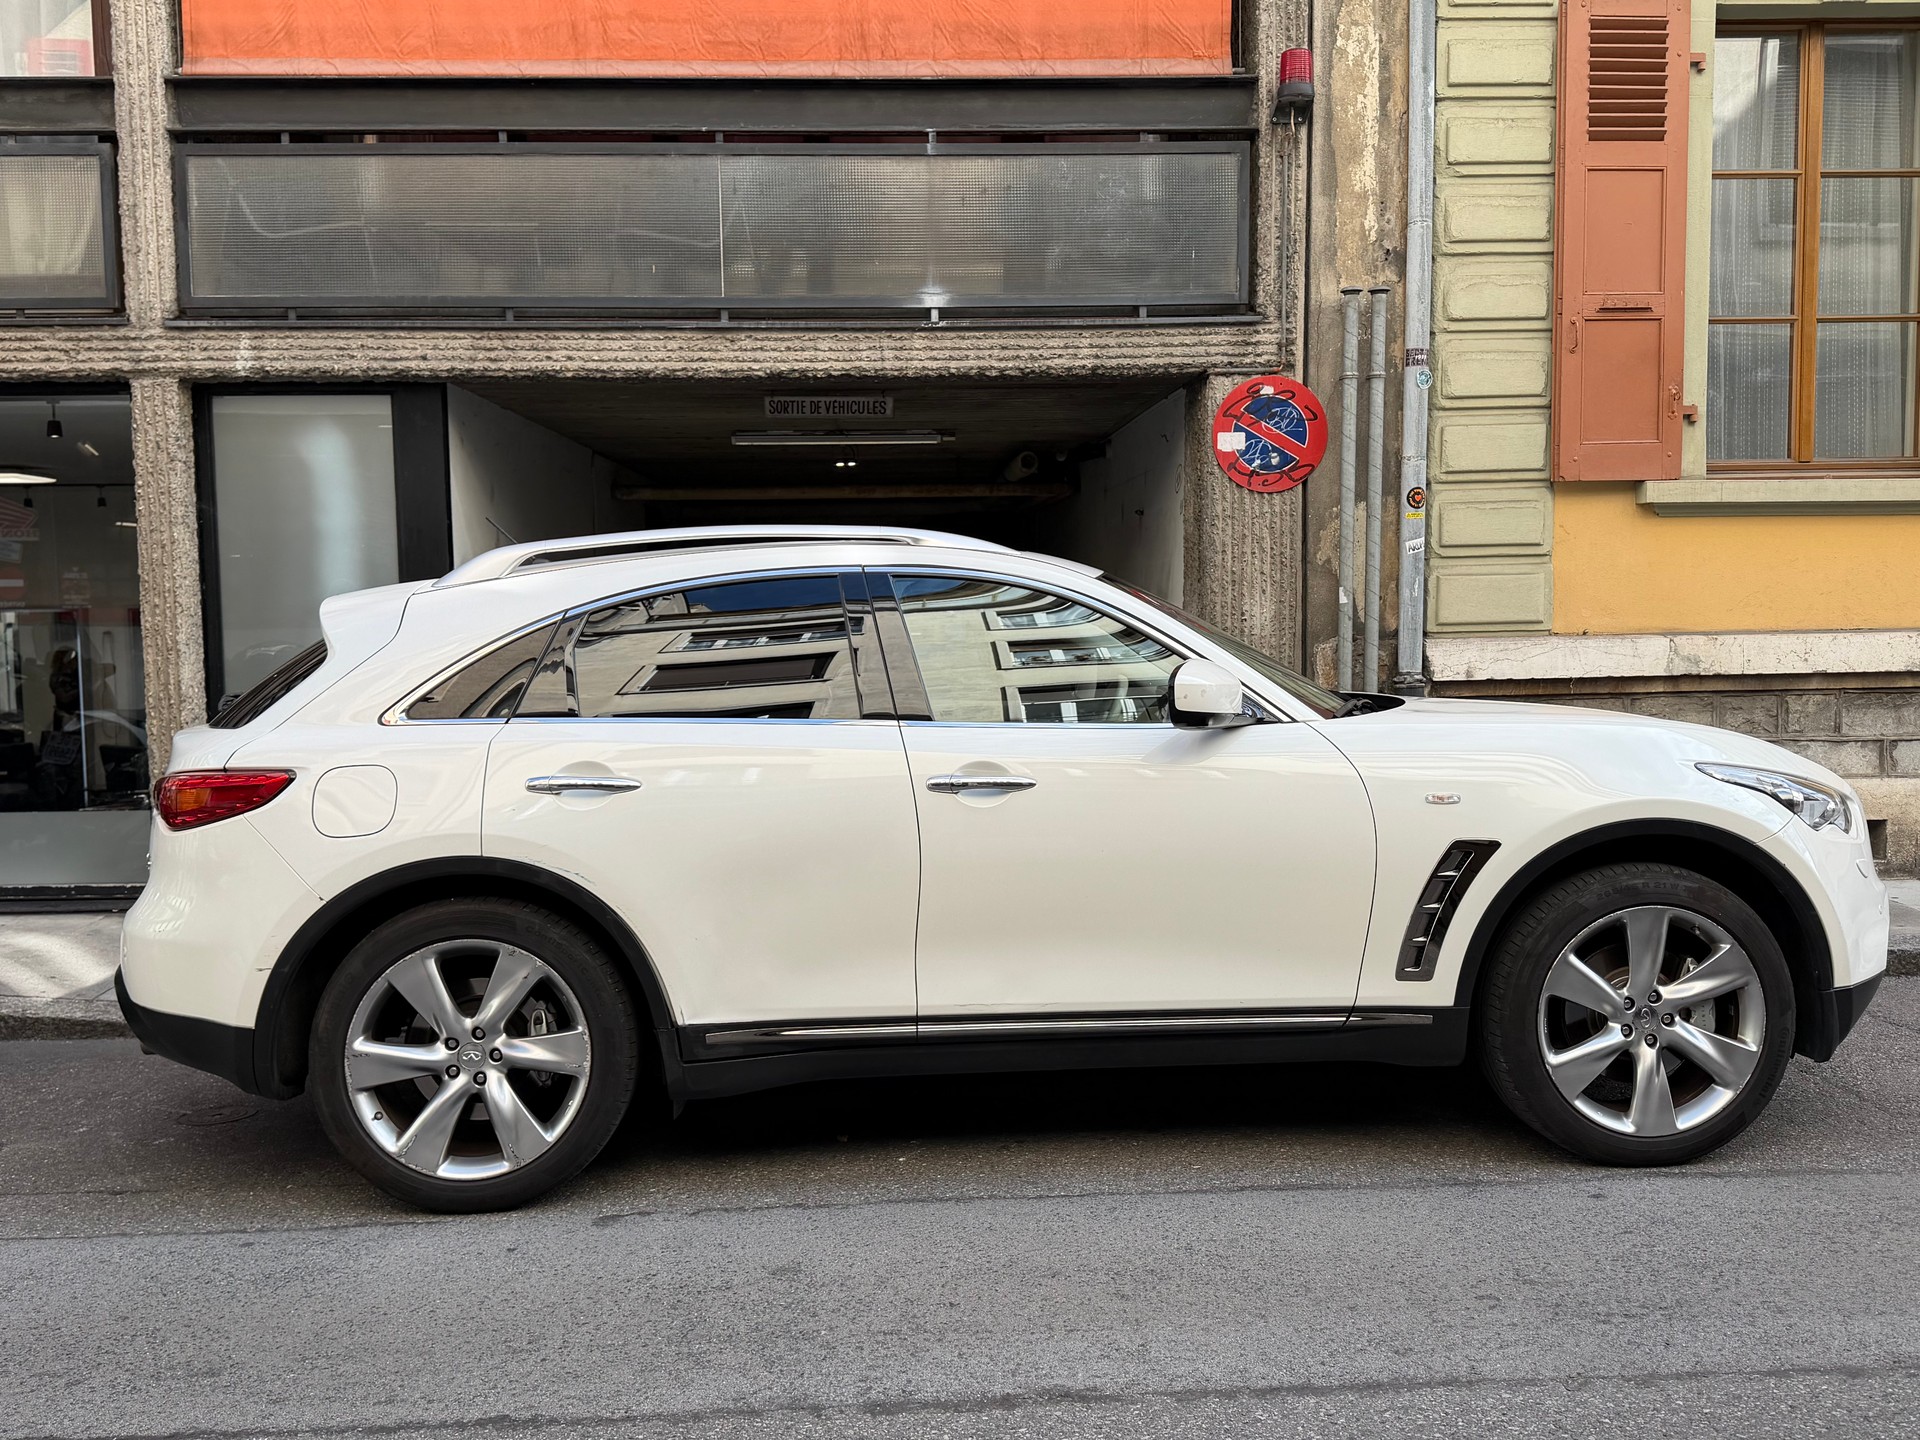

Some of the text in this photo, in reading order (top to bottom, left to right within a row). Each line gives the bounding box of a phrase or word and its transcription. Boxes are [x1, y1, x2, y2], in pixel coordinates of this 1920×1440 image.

[768, 399, 887, 415] SORTIE DE VÉHICULES
